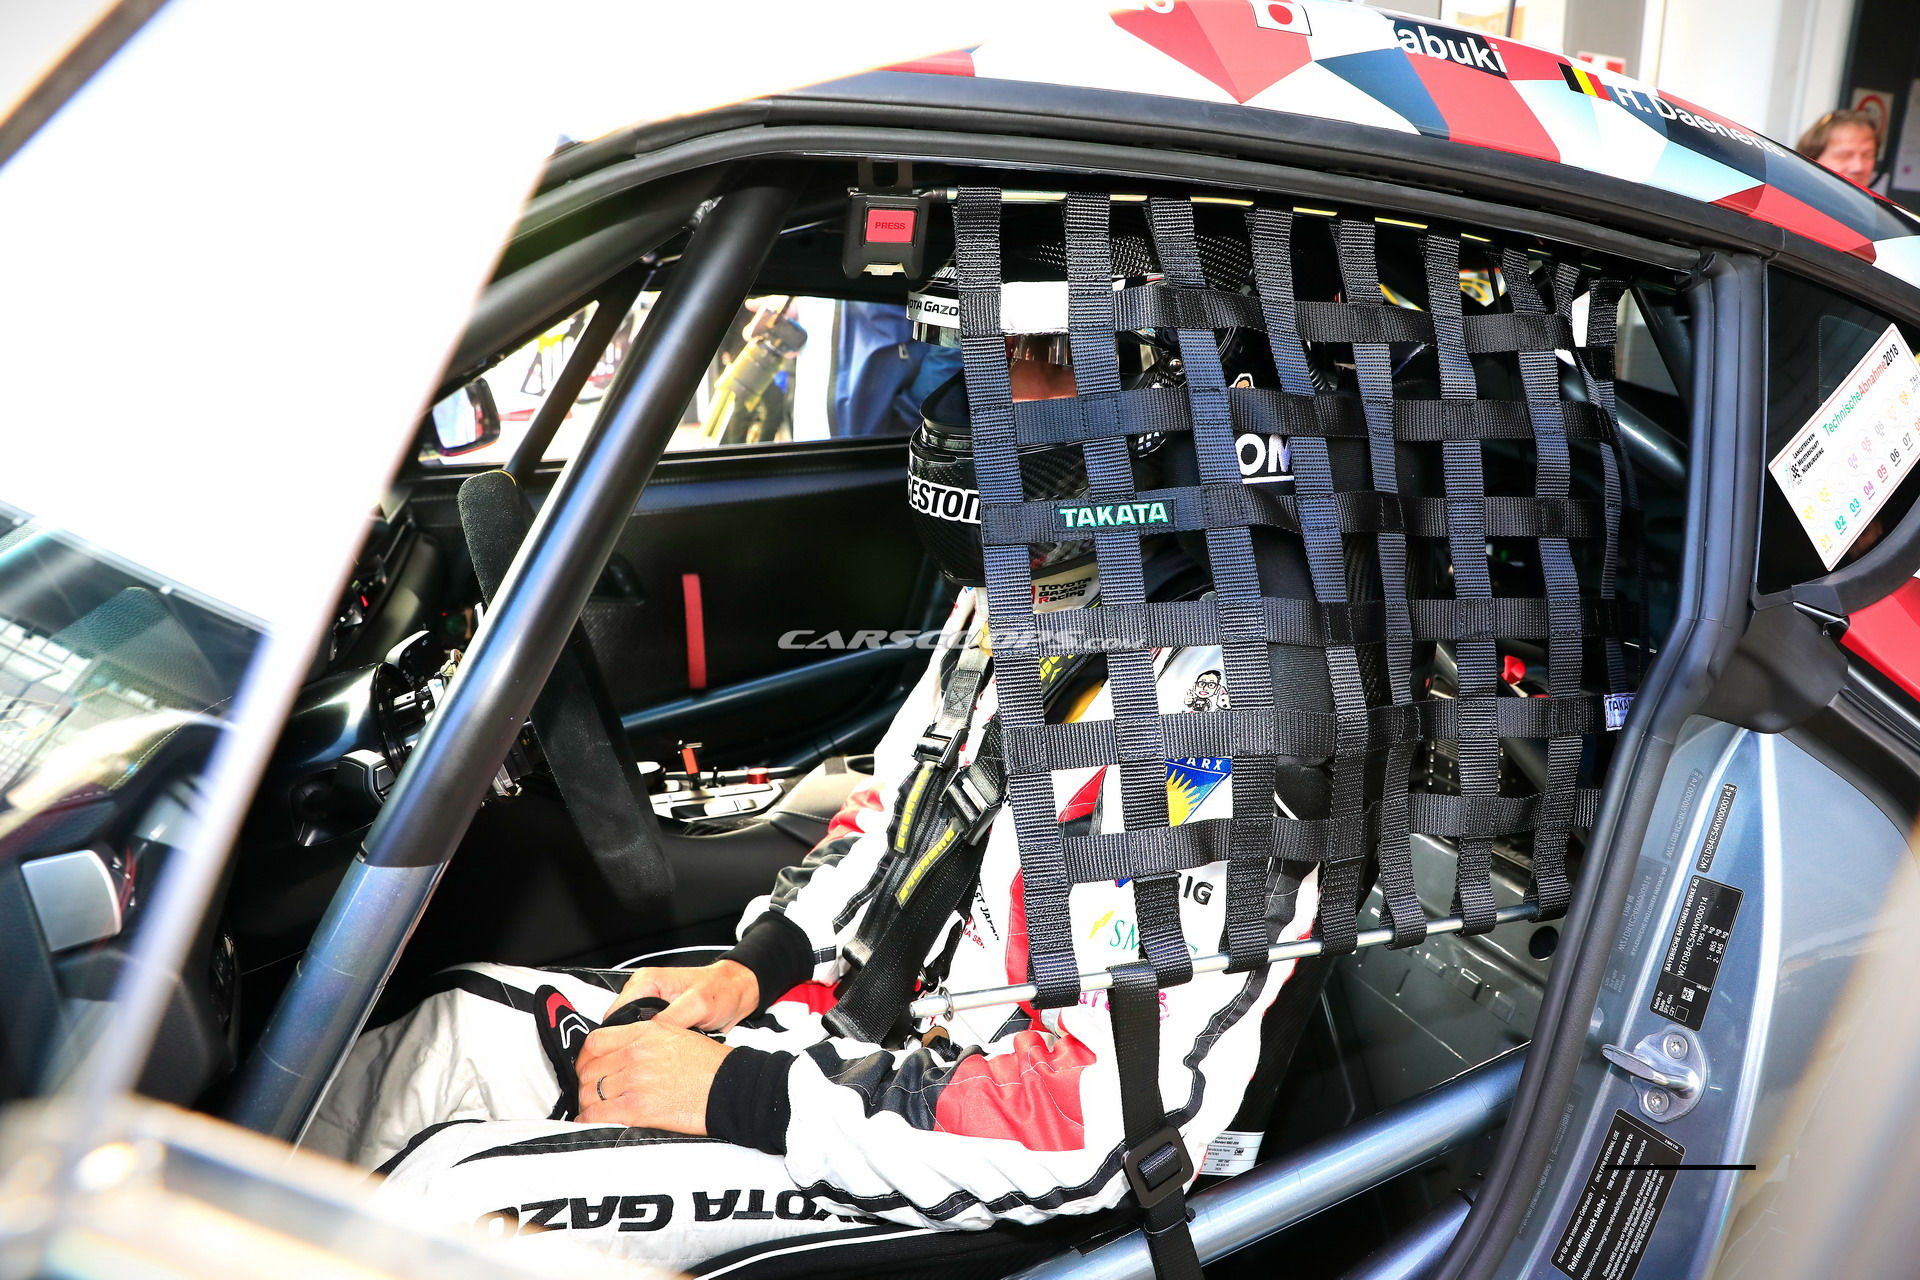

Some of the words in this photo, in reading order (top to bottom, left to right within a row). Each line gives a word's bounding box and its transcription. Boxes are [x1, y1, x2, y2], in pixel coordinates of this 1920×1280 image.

[1392, 20, 1508, 75] abuki
[1653, 96, 1788, 159] Daenens
[874, 221, 906, 230] PRESS
[1874, 420, 1884, 434] 06
[1861, 436, 1871, 451] 05
[1902, 432, 1911, 446] 07
[1847, 452, 1857, 467] 04
[1889, 447, 1899, 462] 06
[1876, 464, 1886, 479] 05
[1862, 480, 1873, 496] 04
[1849, 497, 1860, 513] 03
[1059, 502, 1169, 528] TAKATA
[1834, 514, 1845, 530] 02
[1039, 577, 1091, 592] TOYOTA
[1039, 584, 1087, 597] GAZOO
[1039, 590, 1086, 605] Racing
[1173, 756, 1222, 771] ARX
[1665, 937, 1680, 970] BAYERISCHE
[1676, 908, 1689, 936] MOTOREN
[1686, 887, 1696, 907] WERKE
[1692, 878, 1699, 887] AG
[1696, 932, 1705, 946] 1795
[1715, 942, 1723, 953] 945
[1594, 1170, 1603, 1182] ONLY
[1603, 1139, 1615, 1161] INTERNAL
[1564, 1235, 1573, 1246] den
[1569, 1215, 1582, 1237] internen
[1579, 1191, 1593, 1216] Gebrauch
[1566, 1216, 1597, 1272] Reifenfülldruck
[1592, 1197, 1606, 1218] siehe
